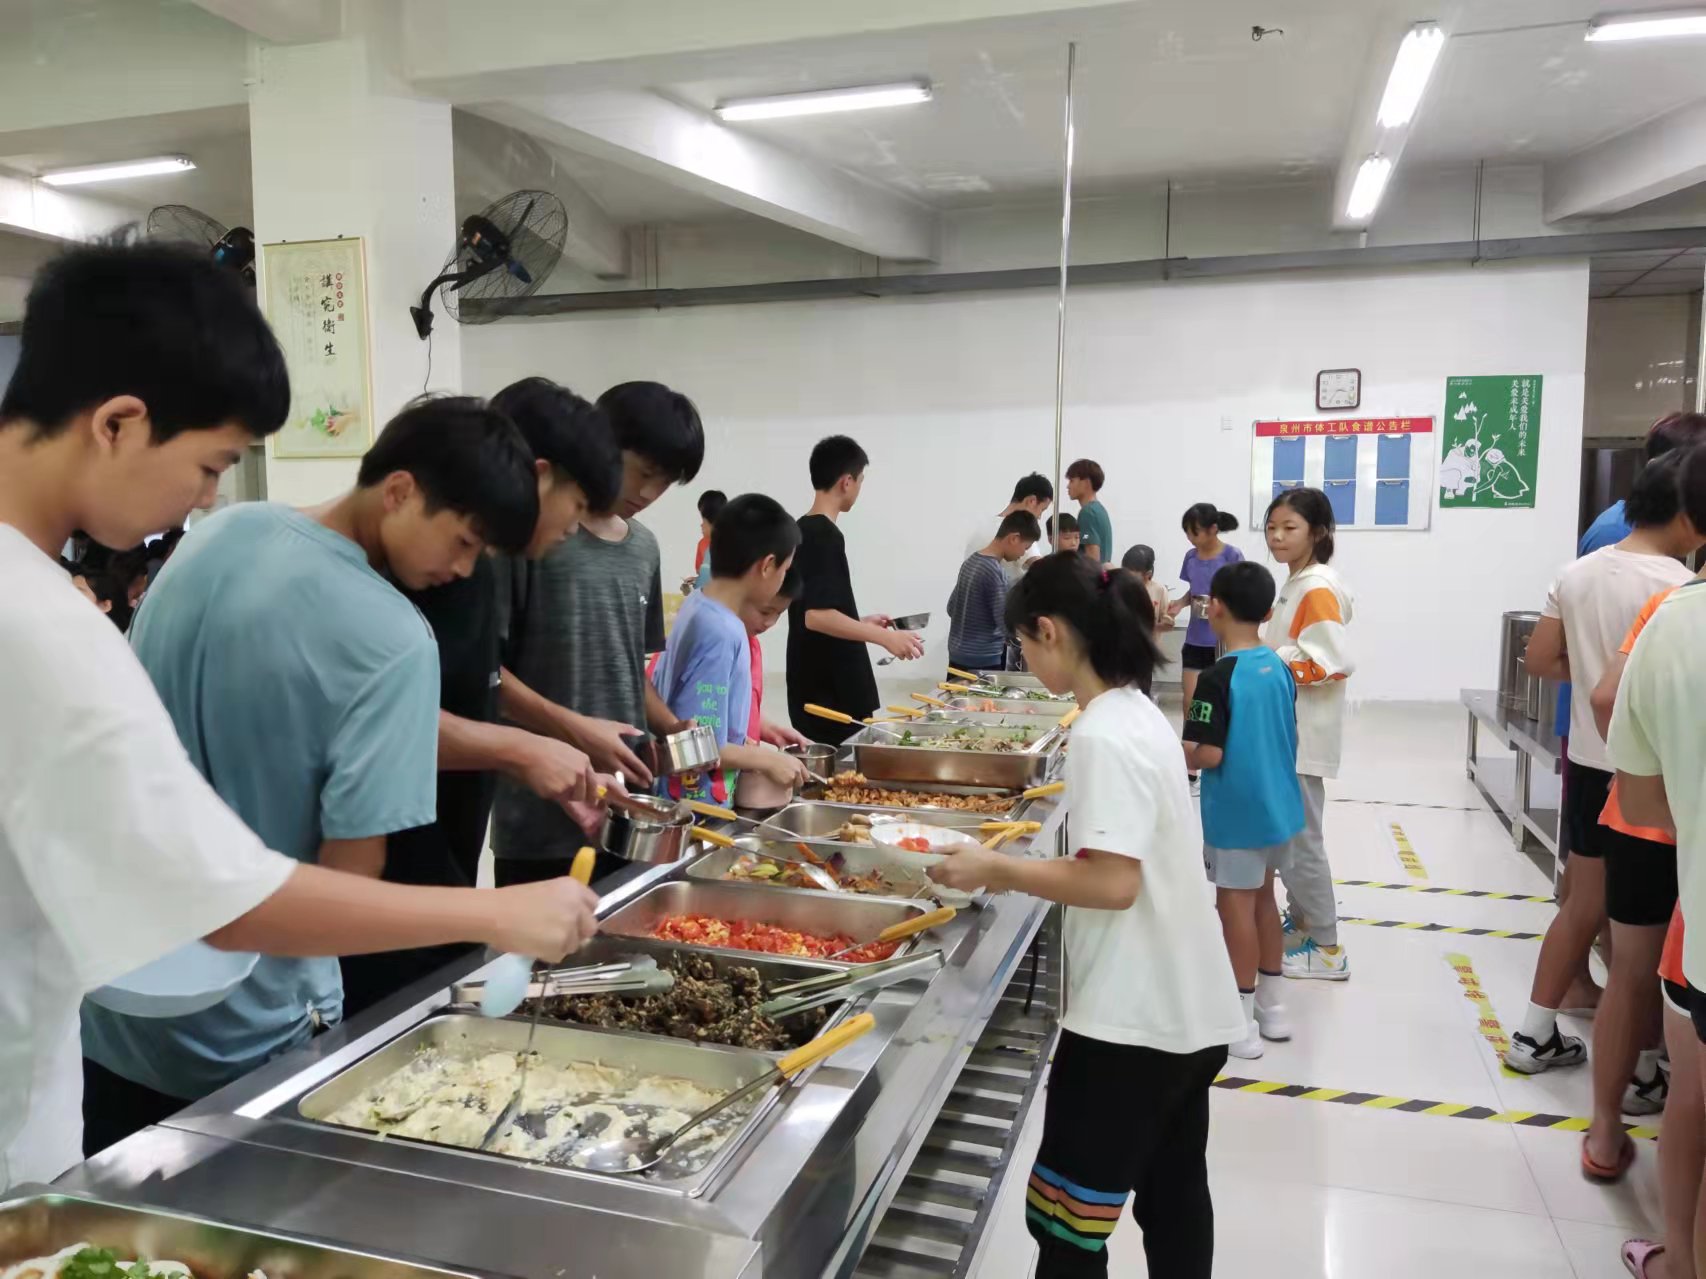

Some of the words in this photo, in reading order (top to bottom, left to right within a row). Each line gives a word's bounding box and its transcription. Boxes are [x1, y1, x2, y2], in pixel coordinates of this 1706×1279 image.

[1279, 420, 1412, 434] 泉州市体工队食谱公告栏
[1507, 379, 1520, 431] 关爱未成年人
[1517, 379, 1530, 456] 就是关爱我们的未来
